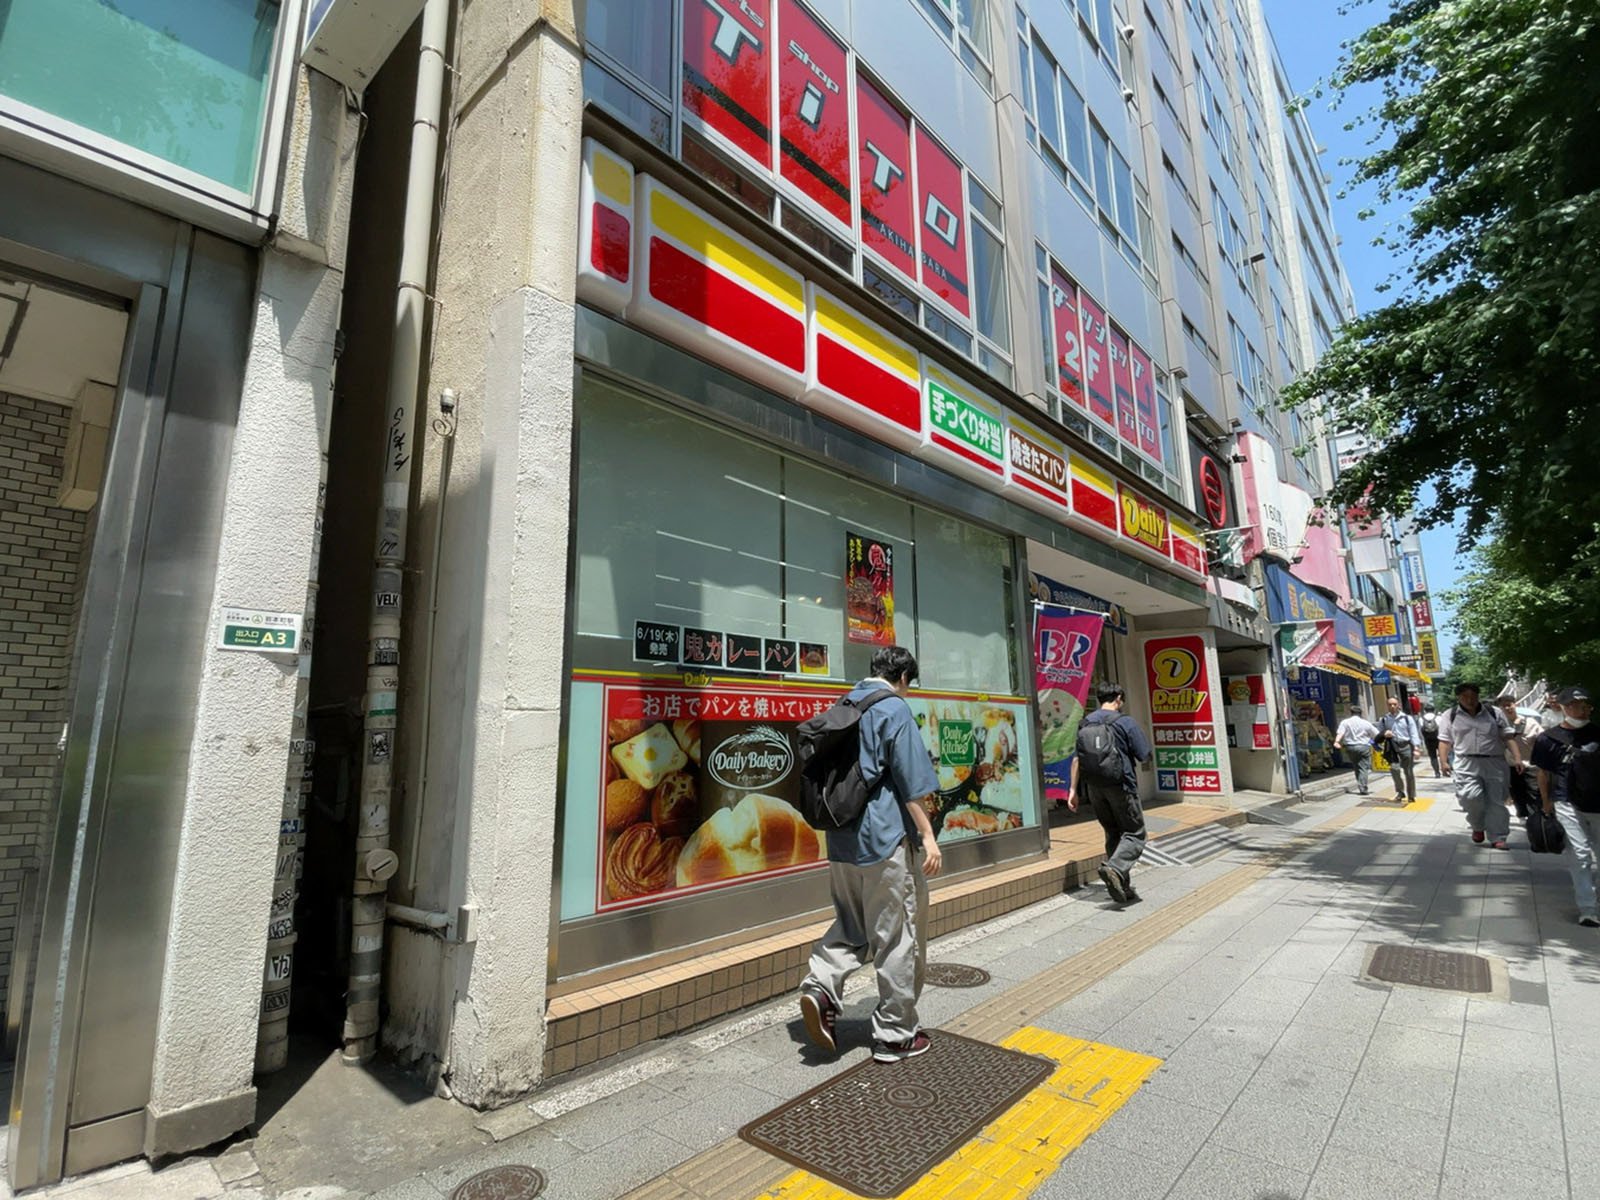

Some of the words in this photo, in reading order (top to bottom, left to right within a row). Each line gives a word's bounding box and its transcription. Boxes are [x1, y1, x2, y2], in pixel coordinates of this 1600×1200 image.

[1065, 331, 1101, 381] 2F
[932, 390, 1001, 456] 手づくり弁当
[1010, 435, 1066, 486] 焼きたてパン
[637, 627, 679, 644] 6/19(木)
[685, 633, 796, 668] 鬼カレーパン
[1153, 689, 1207, 712] Daily
[1156, 729, 1213, 744] 焼きたてパン
[715, 752, 748, 774] Daily
[748, 750, 787, 772] Bakery
[1159, 752, 1215, 766] 手づくり弁当
[1180, 772, 1220, 789] たばこ
